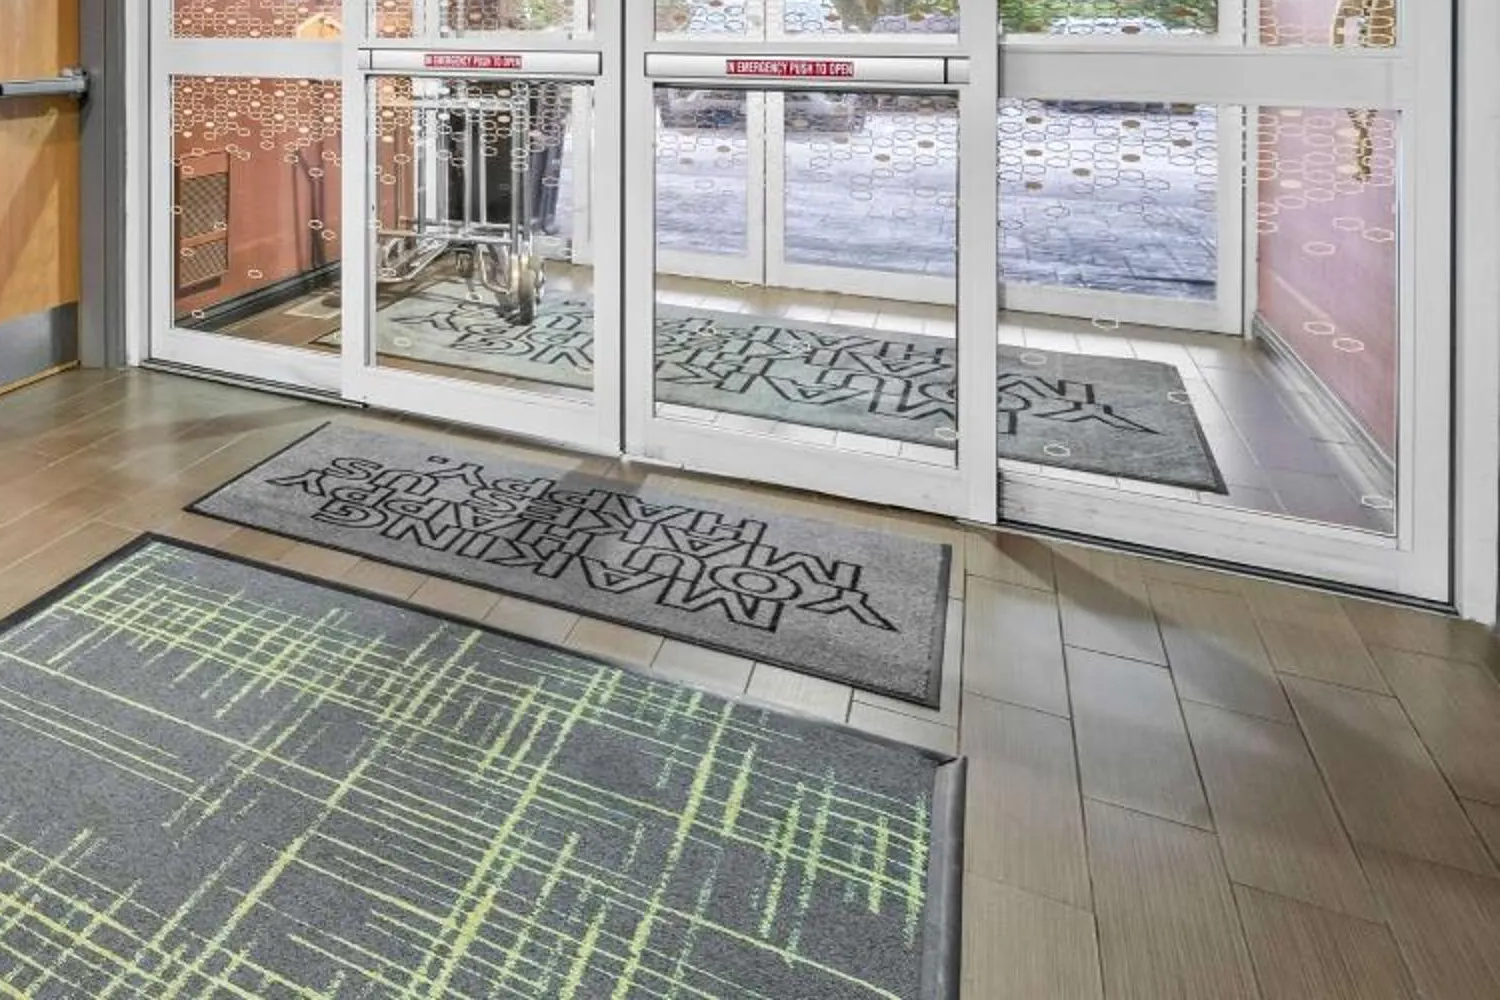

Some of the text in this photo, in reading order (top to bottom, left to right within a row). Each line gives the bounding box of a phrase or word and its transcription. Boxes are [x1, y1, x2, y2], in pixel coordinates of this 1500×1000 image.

[737, 61, 787, 74] EMERGENCY
[789, 62, 814, 75] PUSH
[815, 63, 827, 75] TO
[829, 63, 852, 76] OPEN
[444, 334, 1017, 436] MAKNG
[265, 468, 900, 632] YOU HAPPY
[320, 456, 862, 592] MAKES US
[425, 454, 767, 545] HAPPY.
[309, 498, 784, 632] MAKING
